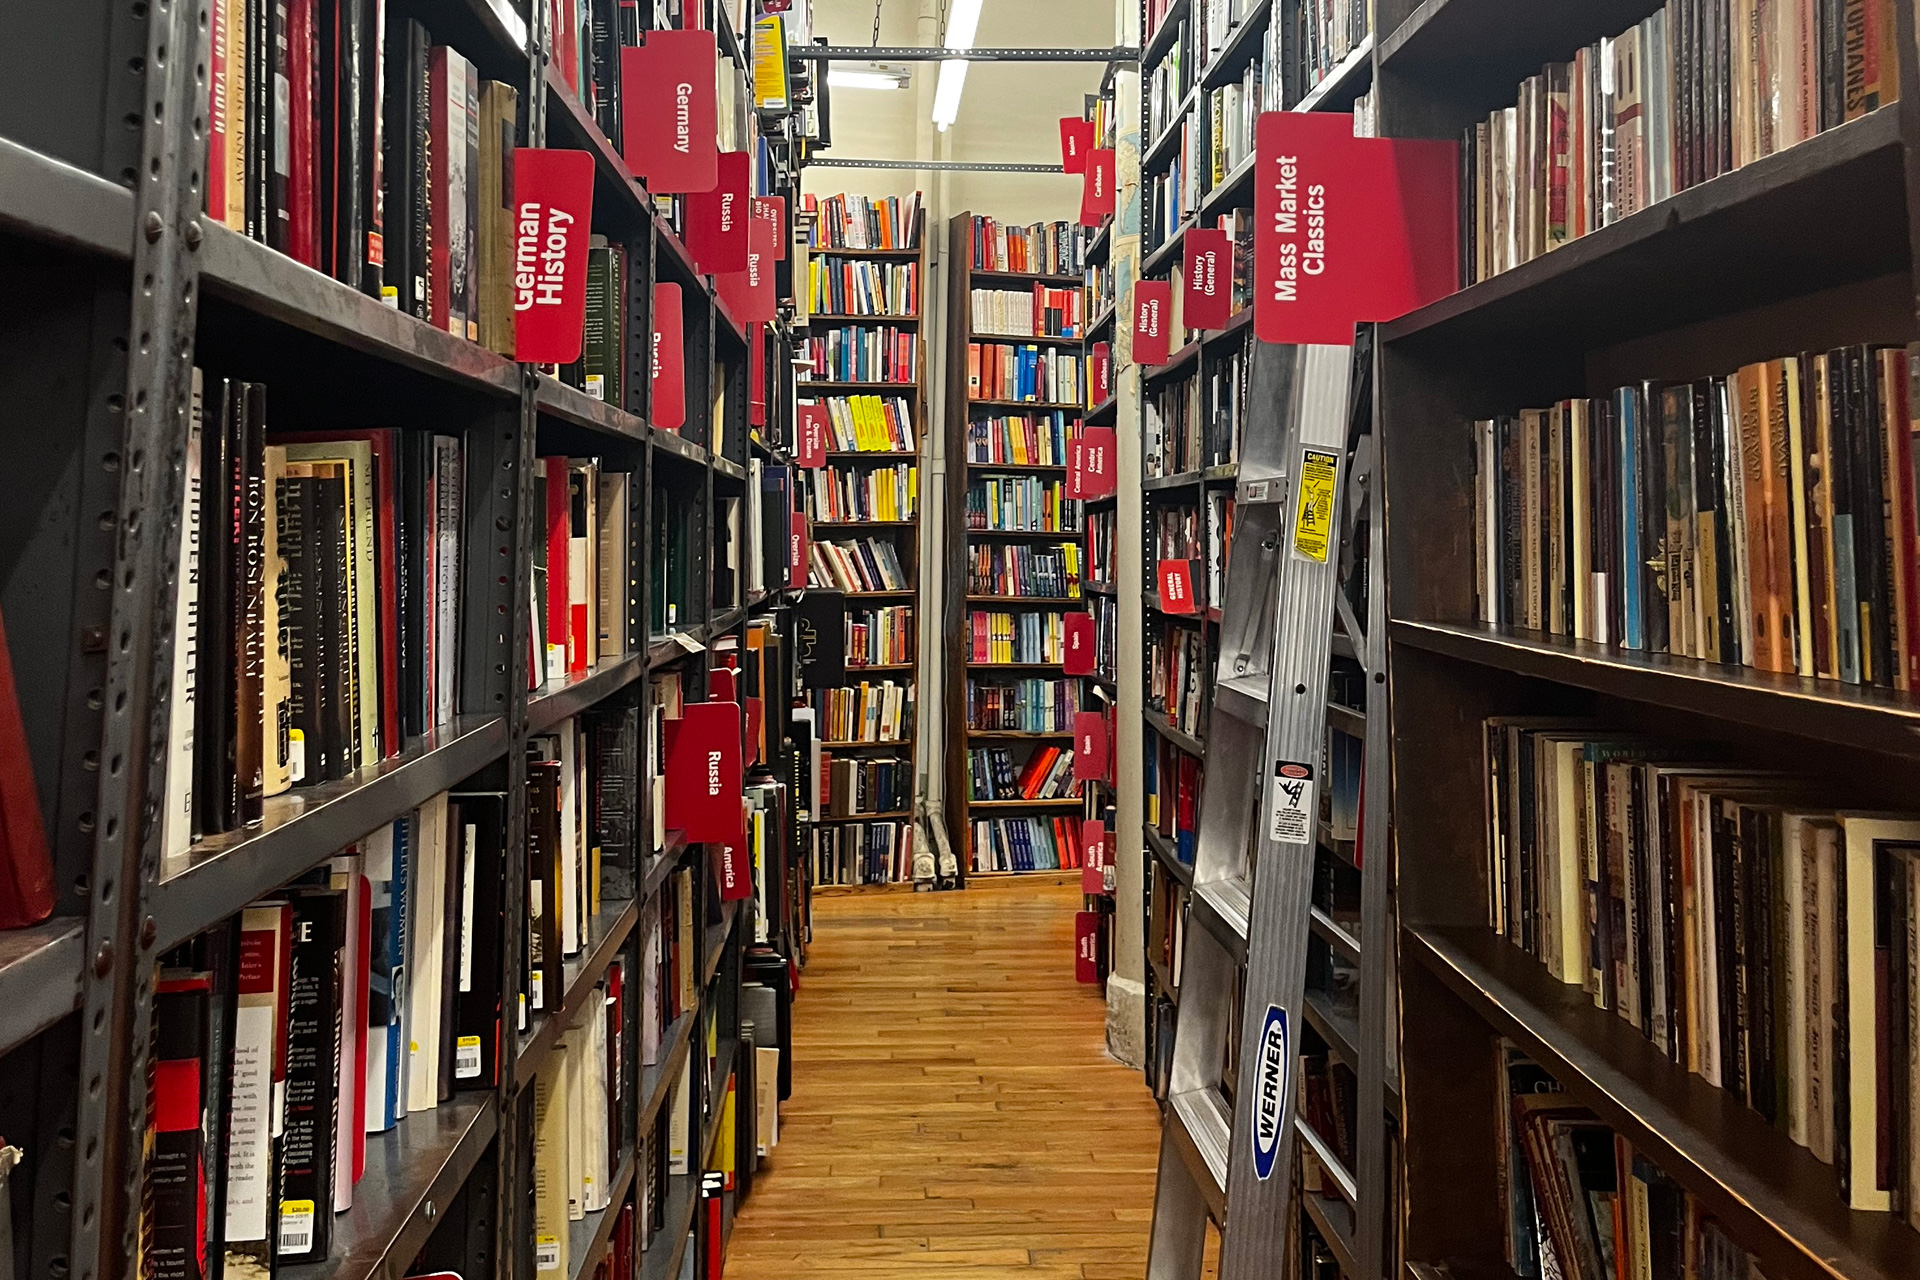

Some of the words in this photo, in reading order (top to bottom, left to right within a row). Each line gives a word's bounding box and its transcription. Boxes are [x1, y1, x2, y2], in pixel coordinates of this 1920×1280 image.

[214, 71, 226, 133] YOUTH
[423, 70, 431, 107] Mind
[674, 83, 693, 153] Germany
[235, 131, 245, 186] KNEW
[1068, 135, 1077, 155] Mexico
[1095, 165, 1103, 198] Caribbean
[1275, 155, 1297, 233] Market
[721, 193, 734, 232] Russia
[1303, 184, 1325, 275] Classics
[515, 203, 541, 312] German
[537, 207, 574, 305] History
[749, 253, 760, 287] Russia
[1193, 254, 1205, 290] History
[1204, 251, 1217, 296] (General)
[1275, 243, 1297, 301] Mass
[1139, 303, 1150, 333] History
[1149, 299, 1160, 337] (General)
[1100, 359, 1108, 390] Caribbean
[191, 393, 202, 439] THE
[364, 463, 372, 487] MY
[1074, 445, 1082, 470] America
[1088, 447, 1096, 473] Central
[1096, 446, 1104, 474] America
[1307, 452, 1334, 465] CAUTION
[1074, 470, 1082, 493] Central
[247, 476, 259, 524] RON
[189, 477, 201, 584] HIDDEN
[364, 496, 373, 562] FRIEND
[791, 534, 800, 566] Oversize
[1166, 572, 1177, 600] GENERAL
[1174, 573, 1184, 599] HISTORY
[245, 535, 258, 677] ROSENBAUM
[186, 600, 199, 704] HITLER
[1071, 631, 1080, 650] Spain
[1083, 734, 1092, 755] Spain
[709, 751, 721, 796] Russia
[822, 831, 830, 853] English
[1088, 845, 1096, 867] South
[1096, 841, 1104, 872] America
[723, 847, 735, 889] America
[398, 883, 410, 956] WOMEN
[1080, 936, 1088, 958] South
[1088, 932, 1097, 962] America
[1260, 1029, 1282, 1139] WERNER
